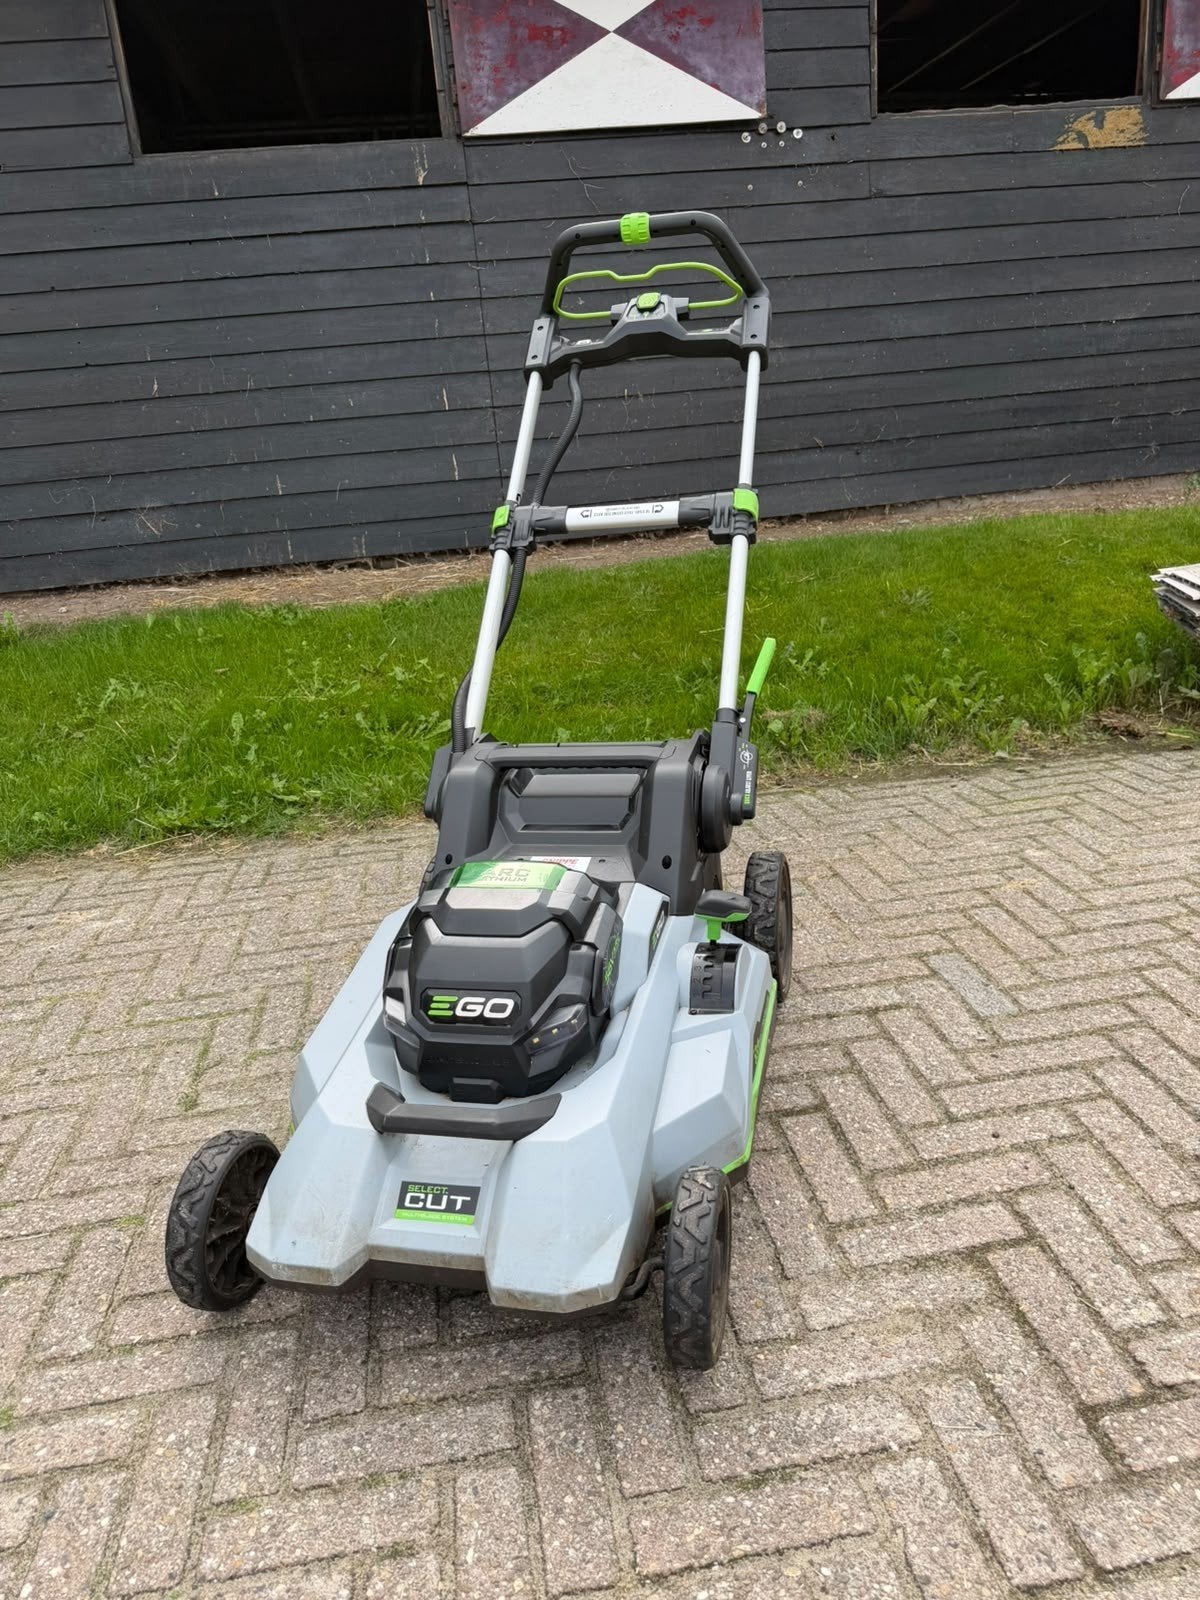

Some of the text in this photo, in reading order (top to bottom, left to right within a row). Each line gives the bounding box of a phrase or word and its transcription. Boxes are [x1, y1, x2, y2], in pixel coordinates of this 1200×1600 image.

[485, 867, 531, 877] ARC
[428, 995, 515, 1019] EGO
[404, 1192, 472, 1211] CUT
